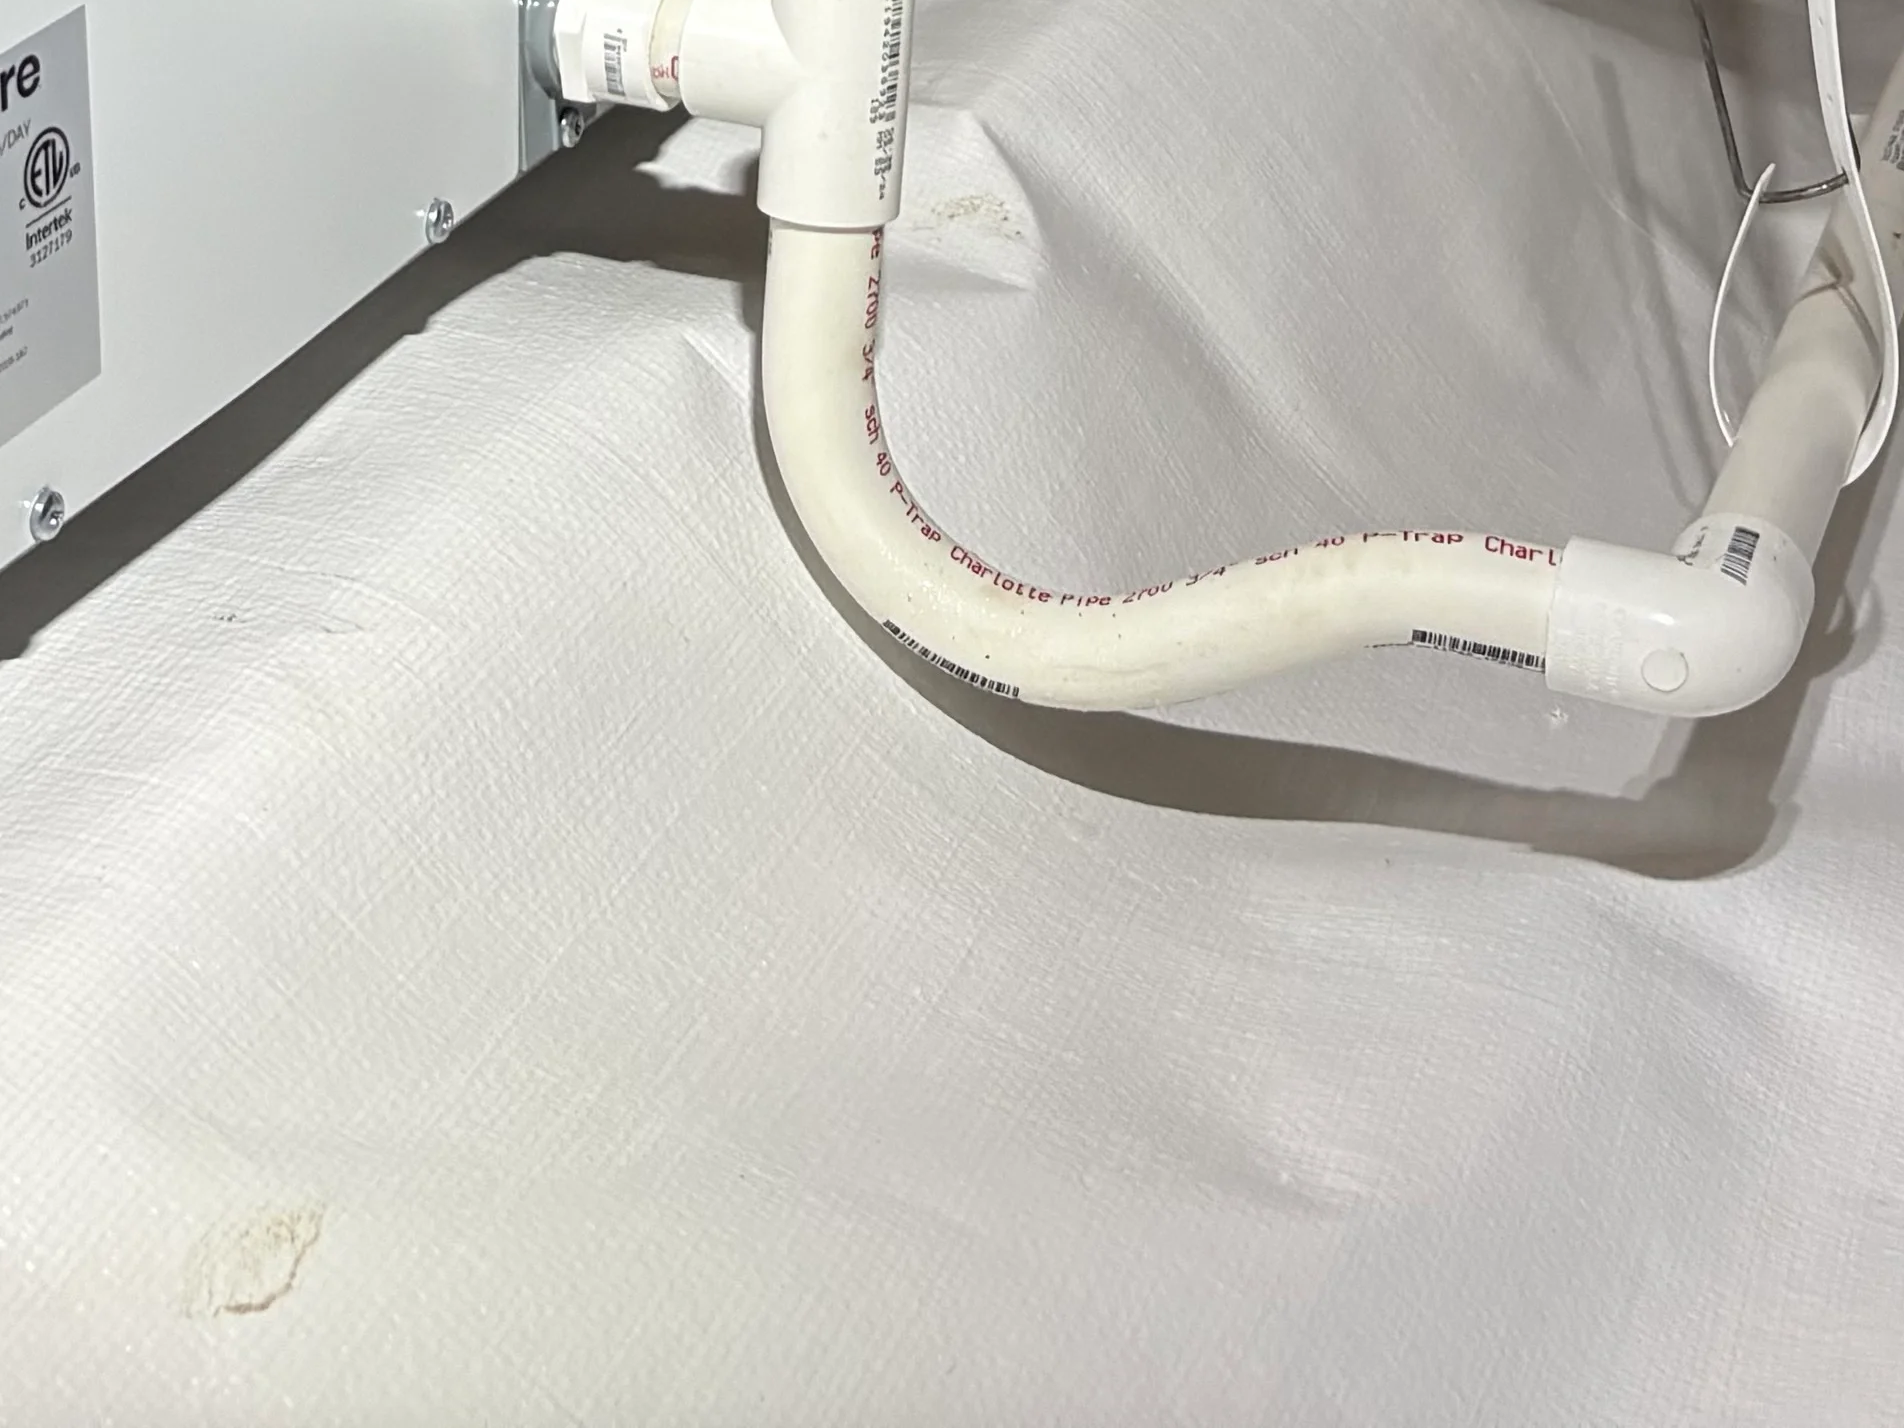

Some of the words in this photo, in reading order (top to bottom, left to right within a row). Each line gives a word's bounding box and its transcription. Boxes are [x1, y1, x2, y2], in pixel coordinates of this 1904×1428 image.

[25, 208, 72, 250] Intertek
[30, 229, 73, 268] 3127179
[876, 451, 892, 477] 40
[890, 479, 942, 542] P-Trap
[949, 545, 1053, 604] Charlotte
[1059, 593, 1112, 608] Pipe
[1484, 535, 1557, 567] Charl
